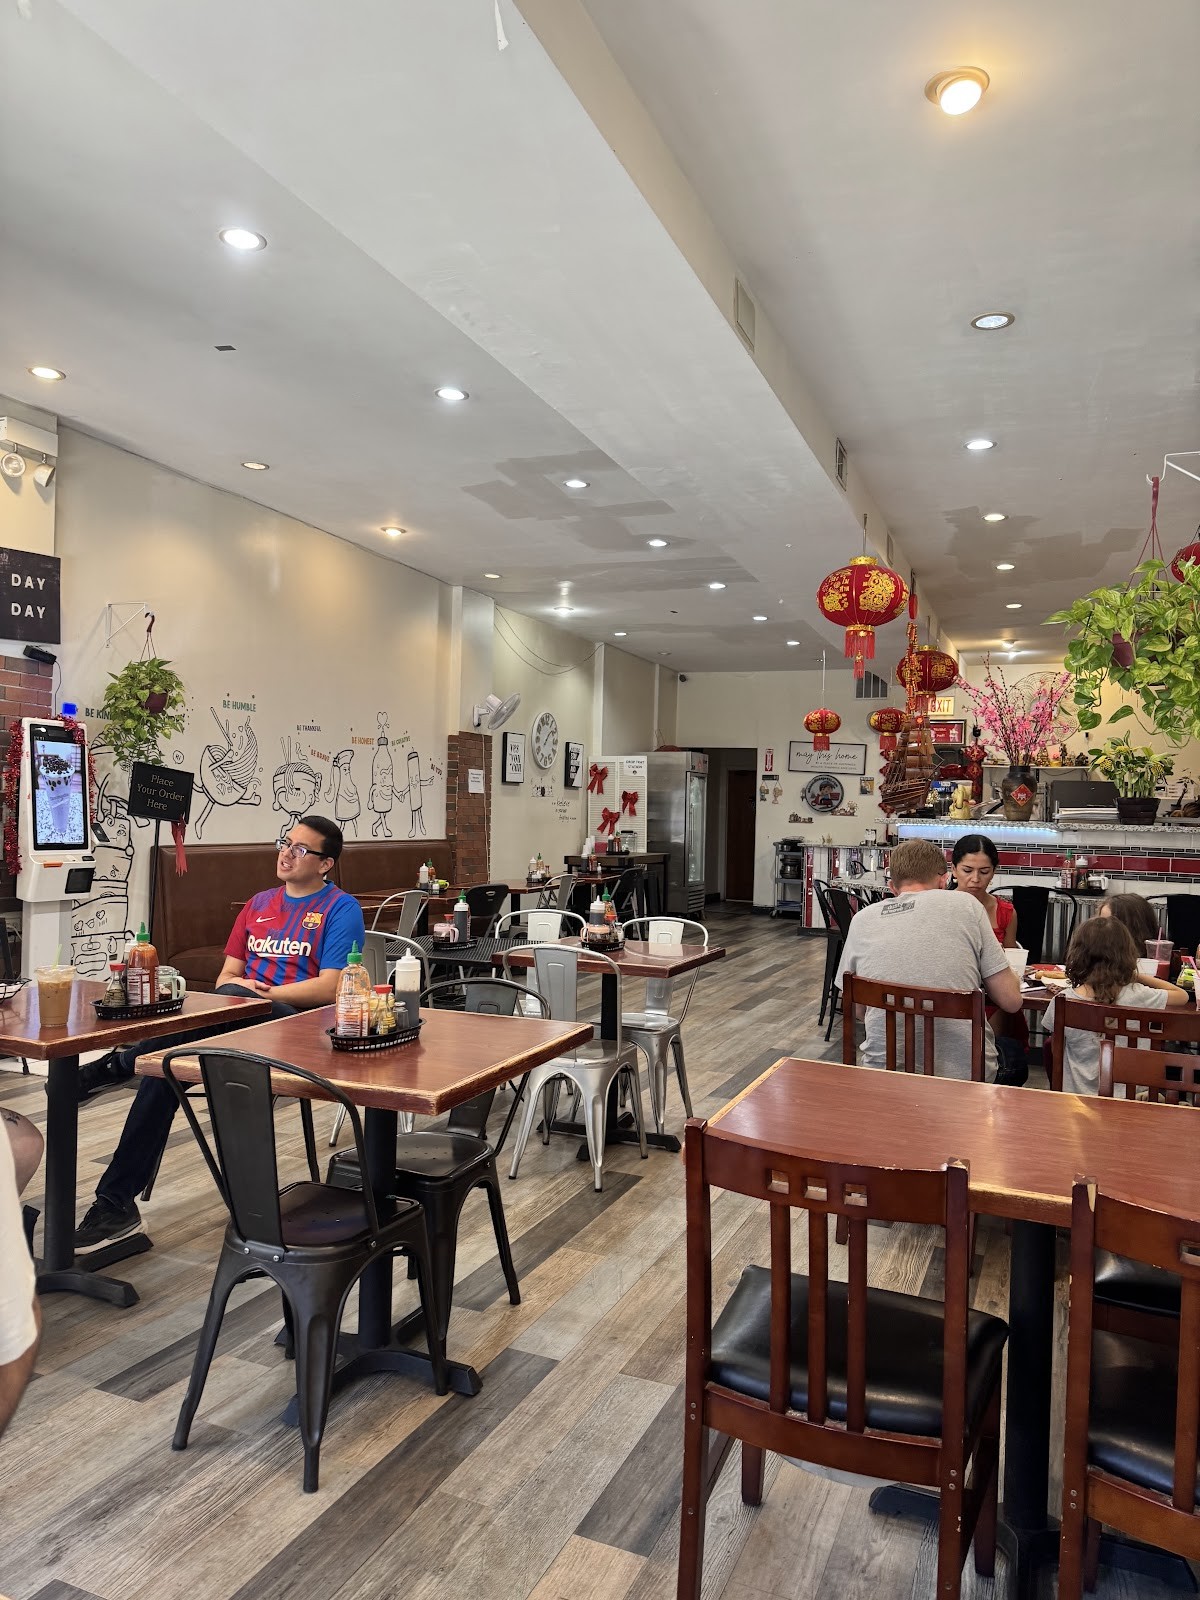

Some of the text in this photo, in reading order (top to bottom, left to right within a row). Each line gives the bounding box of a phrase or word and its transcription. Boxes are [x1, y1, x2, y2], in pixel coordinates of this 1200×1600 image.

[11, 573, 46, 590] DAY
[11, 602, 46, 618] DAY
[222, 700, 257, 712] BE HUMBLE
[930, 700, 951, 712] EXIT
[85, 708, 111, 720] BE KIN
[358, 737, 374, 745] HONEST
[796, 751, 814, 764] may
[835, 748, 858, 760] home
[151, 774, 174, 787] Place
[137, 783, 185, 801] Your Order
[147, 799, 167, 810] Here
[247, 935, 311, 956] Rakuten
